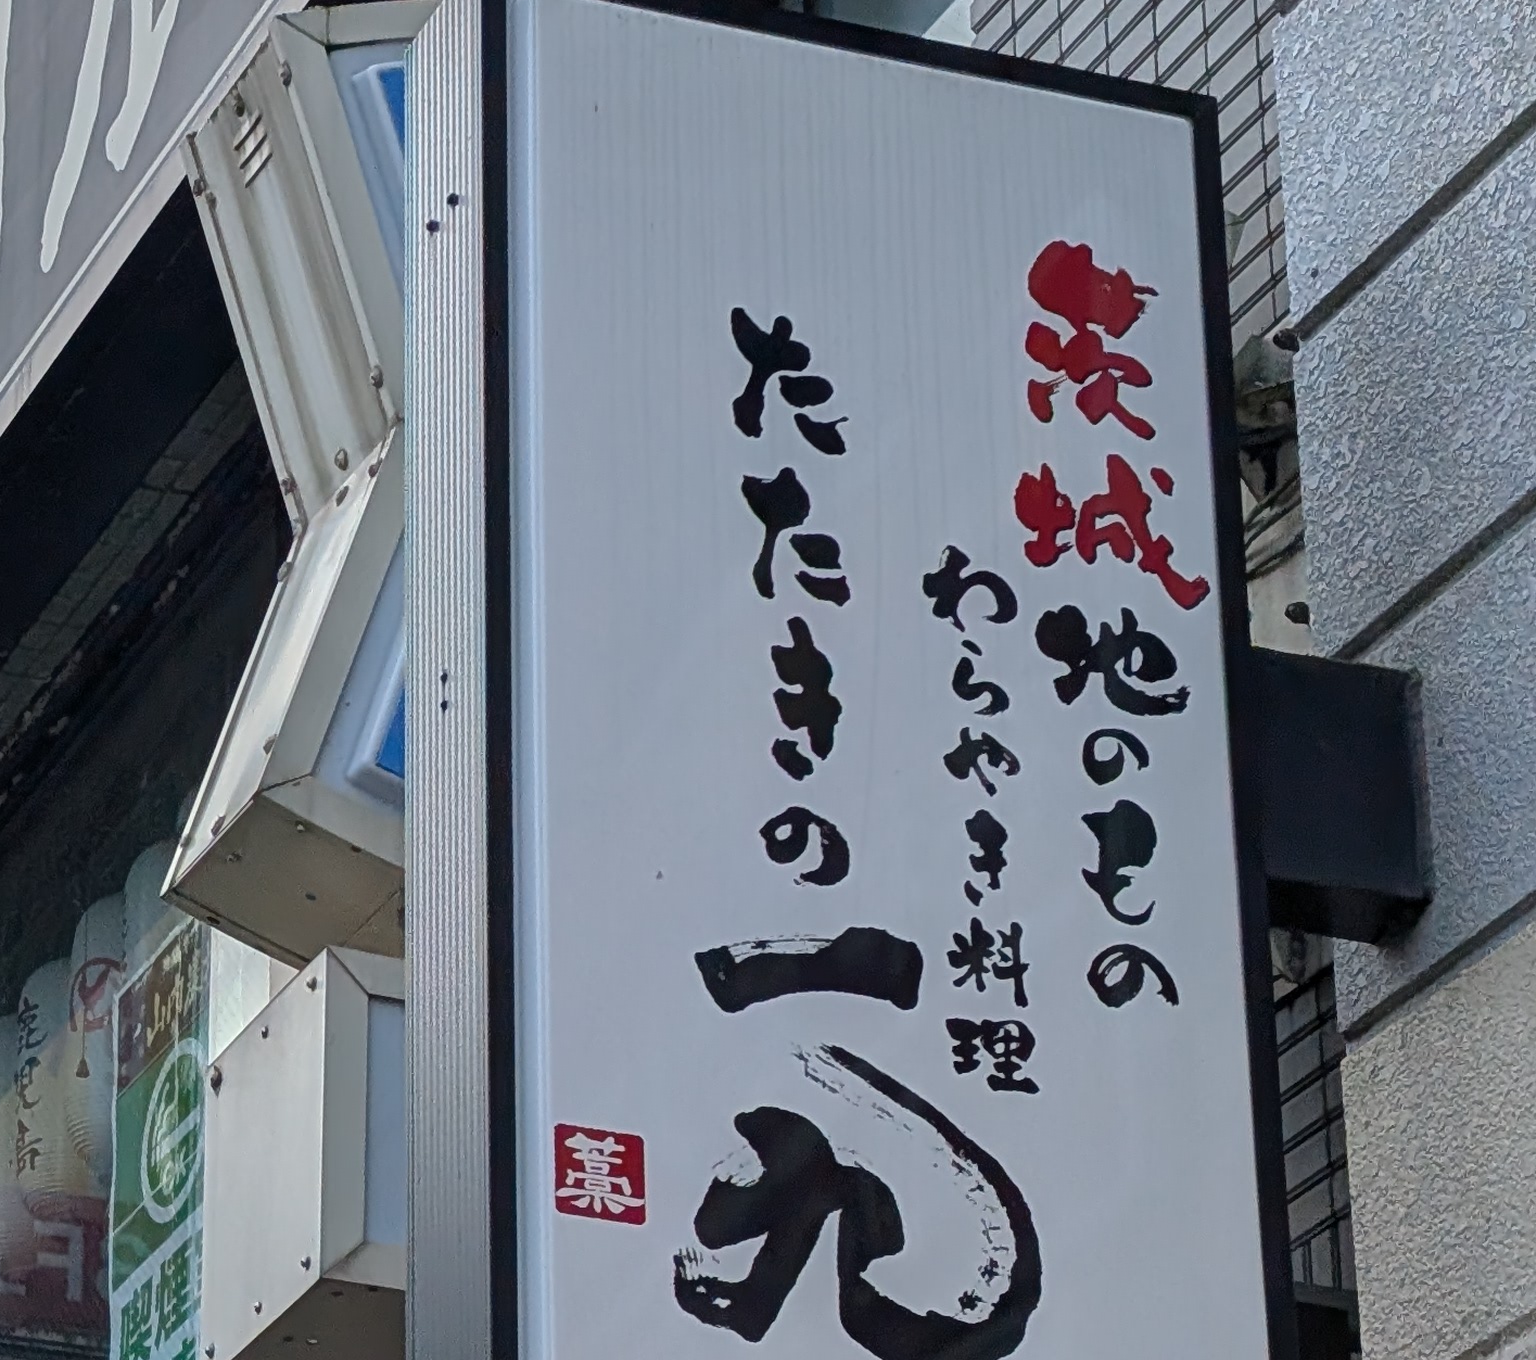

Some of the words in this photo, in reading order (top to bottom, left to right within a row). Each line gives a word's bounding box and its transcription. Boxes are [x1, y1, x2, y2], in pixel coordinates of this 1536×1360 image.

[922, 546, 1040, 1094] わらやき料理
